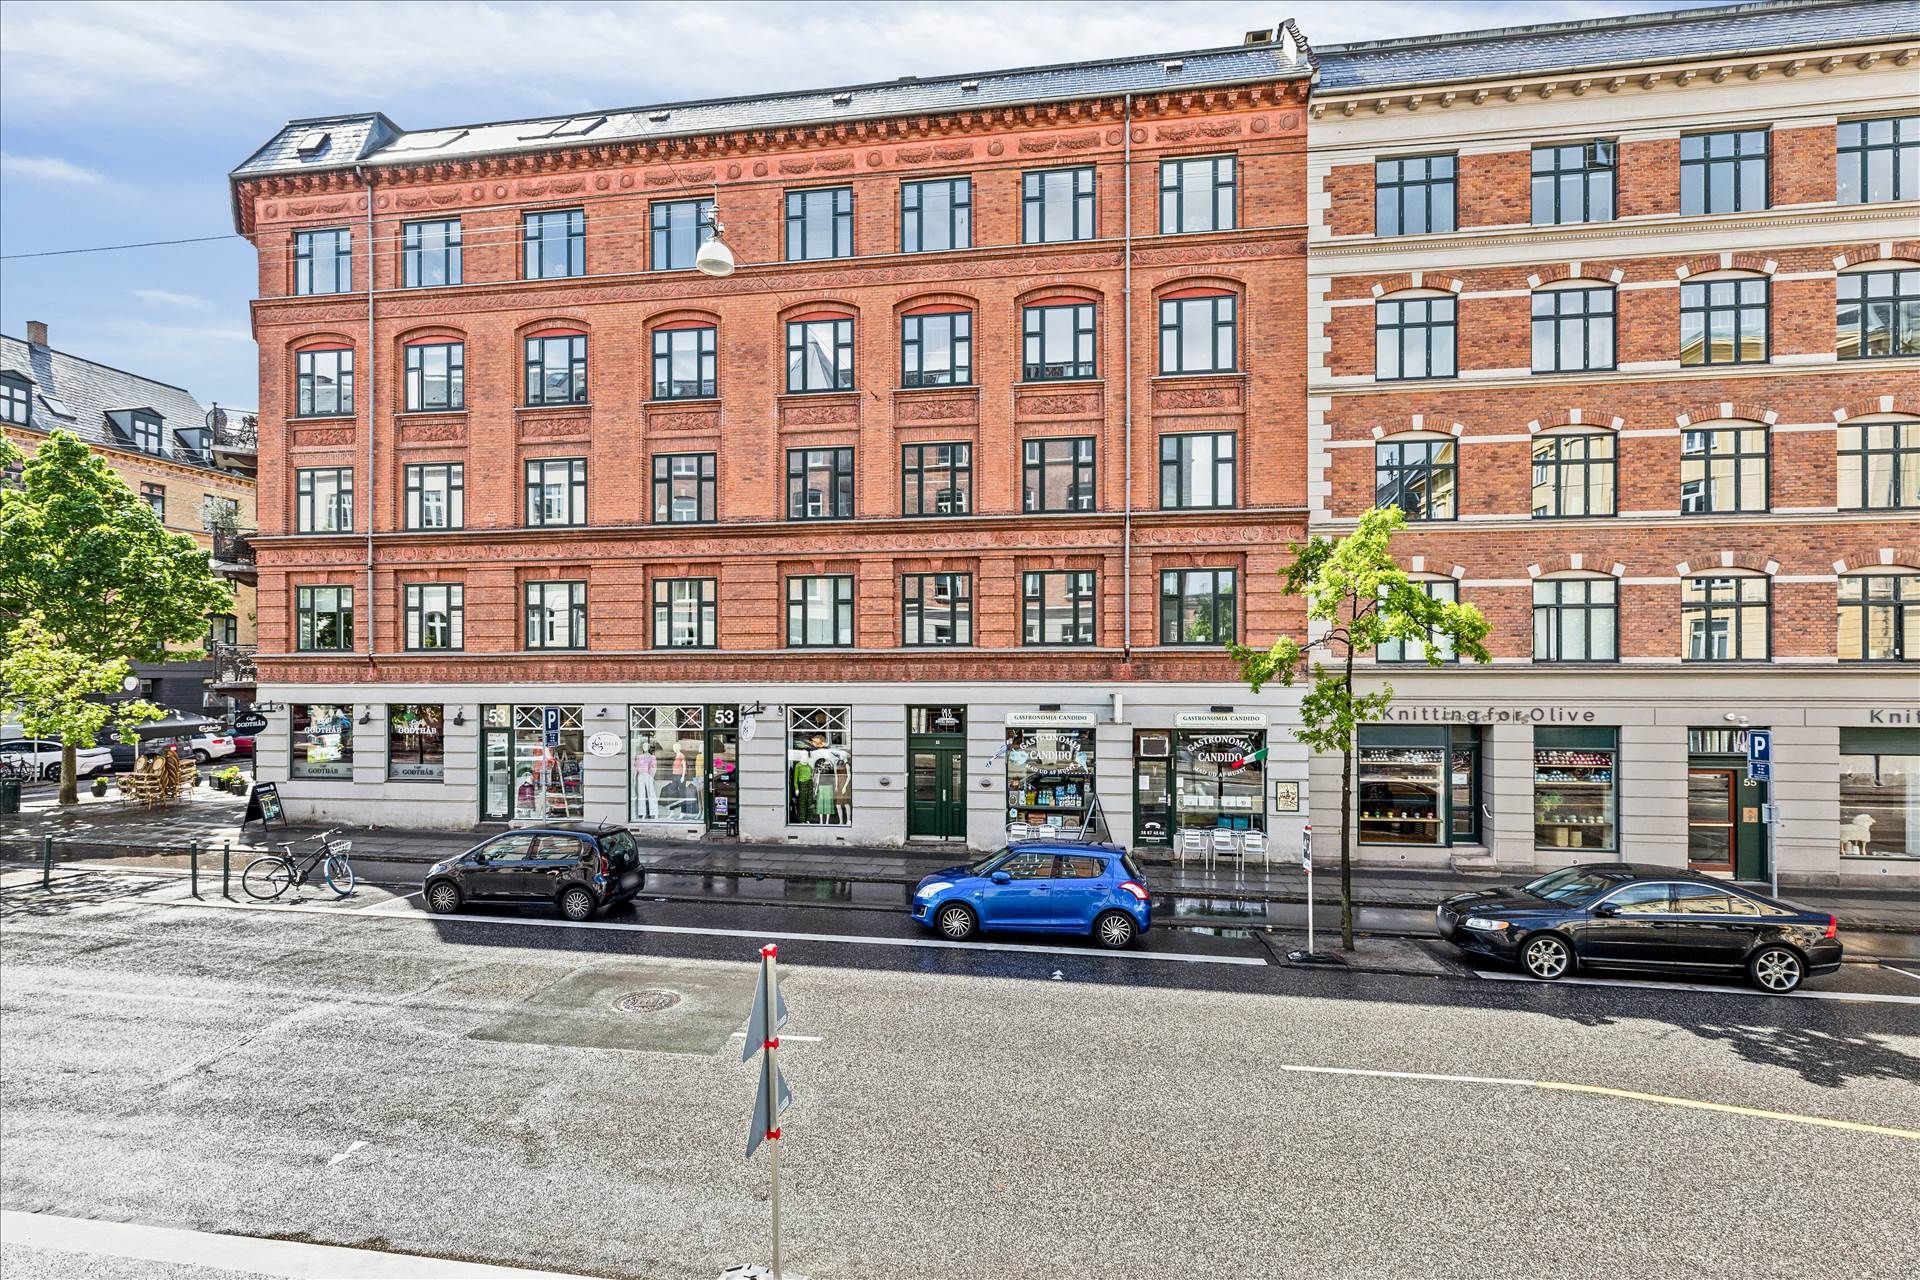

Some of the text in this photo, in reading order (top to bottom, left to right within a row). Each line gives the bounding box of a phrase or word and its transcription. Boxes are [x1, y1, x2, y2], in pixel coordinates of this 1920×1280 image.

[488, 709, 506, 722] 53
[547, 710, 556, 729] P
[714, 709, 735, 724] 53
[1382, 707, 1595, 724] Knitting for Olive
[236, 720, 266, 728] GODTHÅB
[304, 725, 342, 734] GODTHÅB
[398, 726, 437, 734] GODTHÅB
[1019, 735, 1081, 751] GASTRONOMIA
[1187, 735, 1252, 753] GASTRONOMIA
[1754, 736, 1766, 758] P
[1029, 751, 1072, 760] CANDIDO
[1197, 752, 1242, 762] CANDIDO
[1743, 778, 1757, 787] 55
